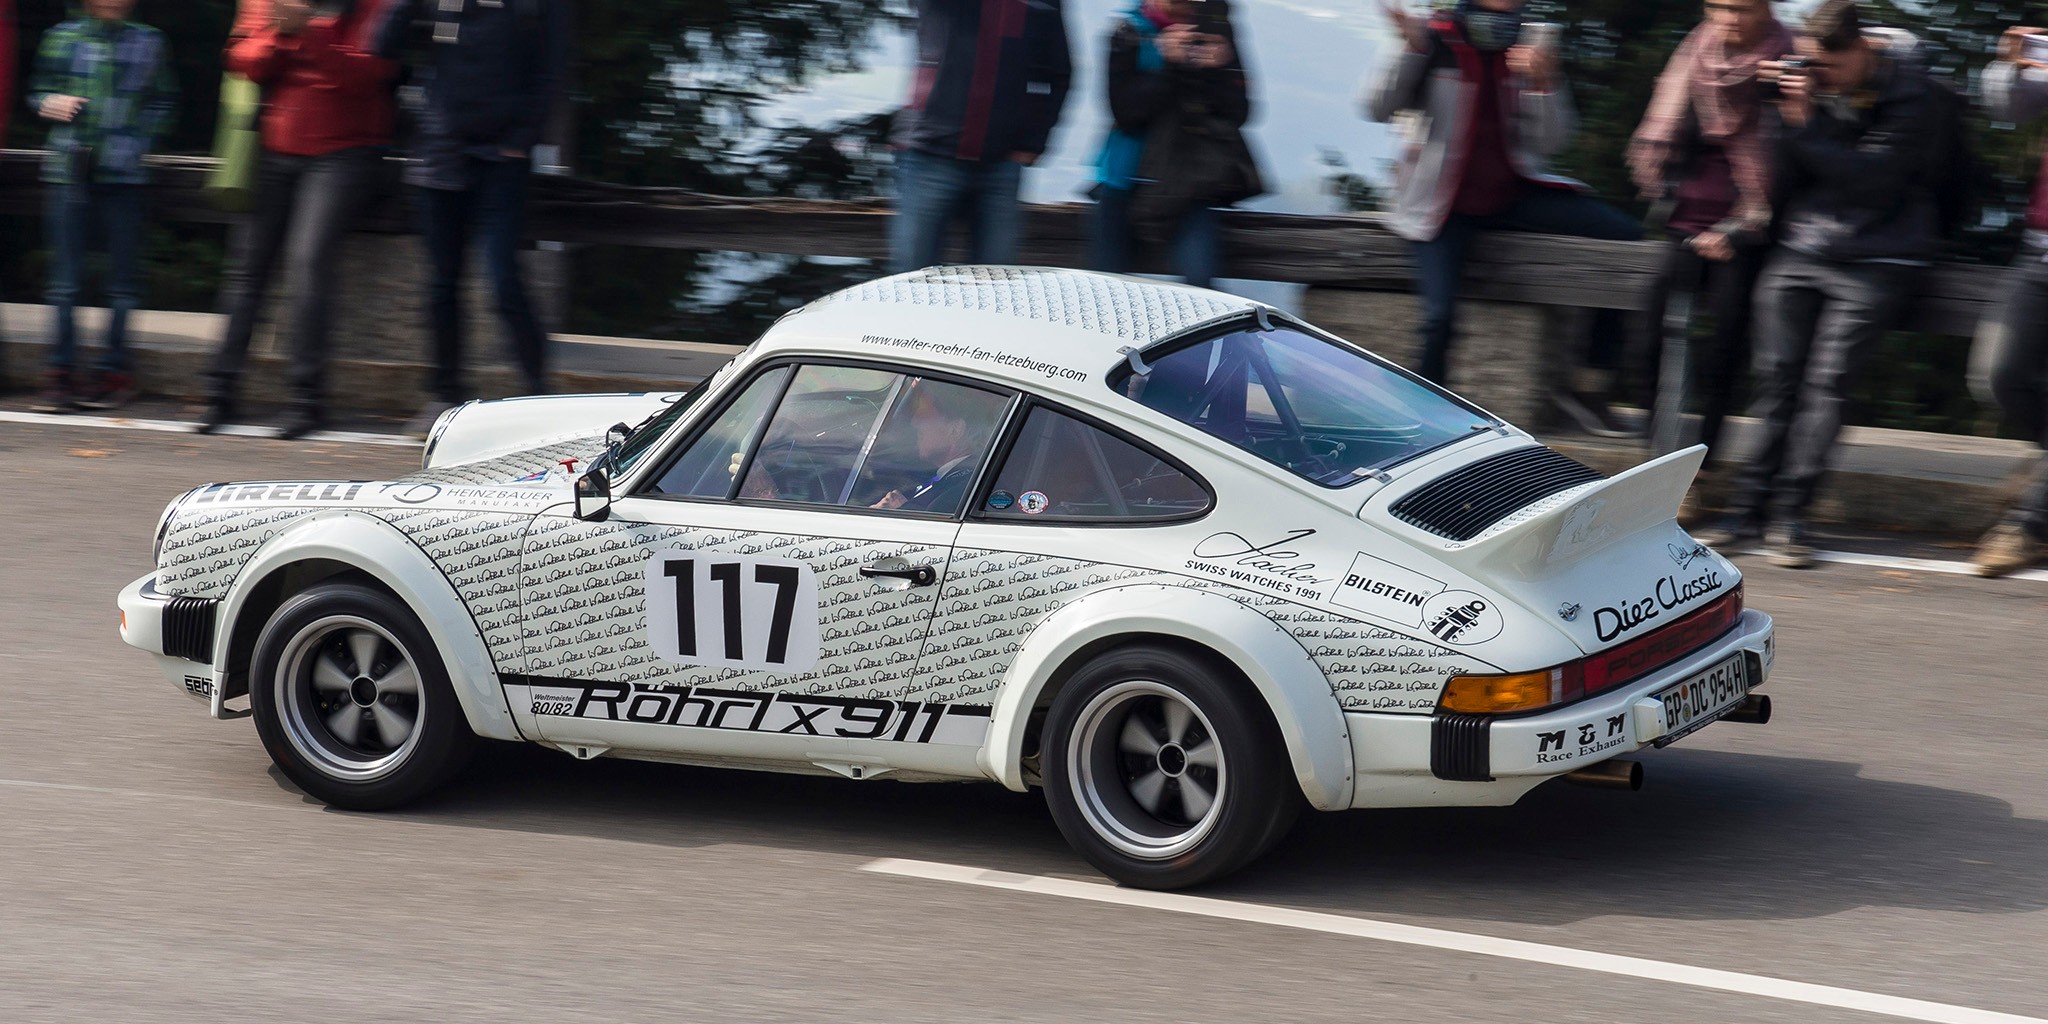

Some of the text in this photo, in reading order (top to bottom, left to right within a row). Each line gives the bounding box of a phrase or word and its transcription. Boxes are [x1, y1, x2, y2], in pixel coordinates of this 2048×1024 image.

[861, 333, 1088, 383] www.walter-roehrl-fan-letzebuerg.com
[457, 499, 541, 508] MANUFAKT
[1184, 560, 1322, 601] SWISS WATCHES 1991
[1344, 573, 1425, 607] BILSTEIN
[664, 559, 800, 664] 117
[1593, 567, 1723, 643] Diez Classic
[1606, 608, 1726, 677] PORSCHE
[530, 701, 573, 715] 80/82
[534, 693, 576, 702] Weltmeister
[573, 683, 775, 731] Röhrl
[834, 699, 947, 743] 911
[1663, 659, 1744, 730] GP DC 954H
[1536, 730, 1566, 752] M
[1606, 712, 1626, 737] M
[1536, 735, 1625, 763] Race Exhaust
